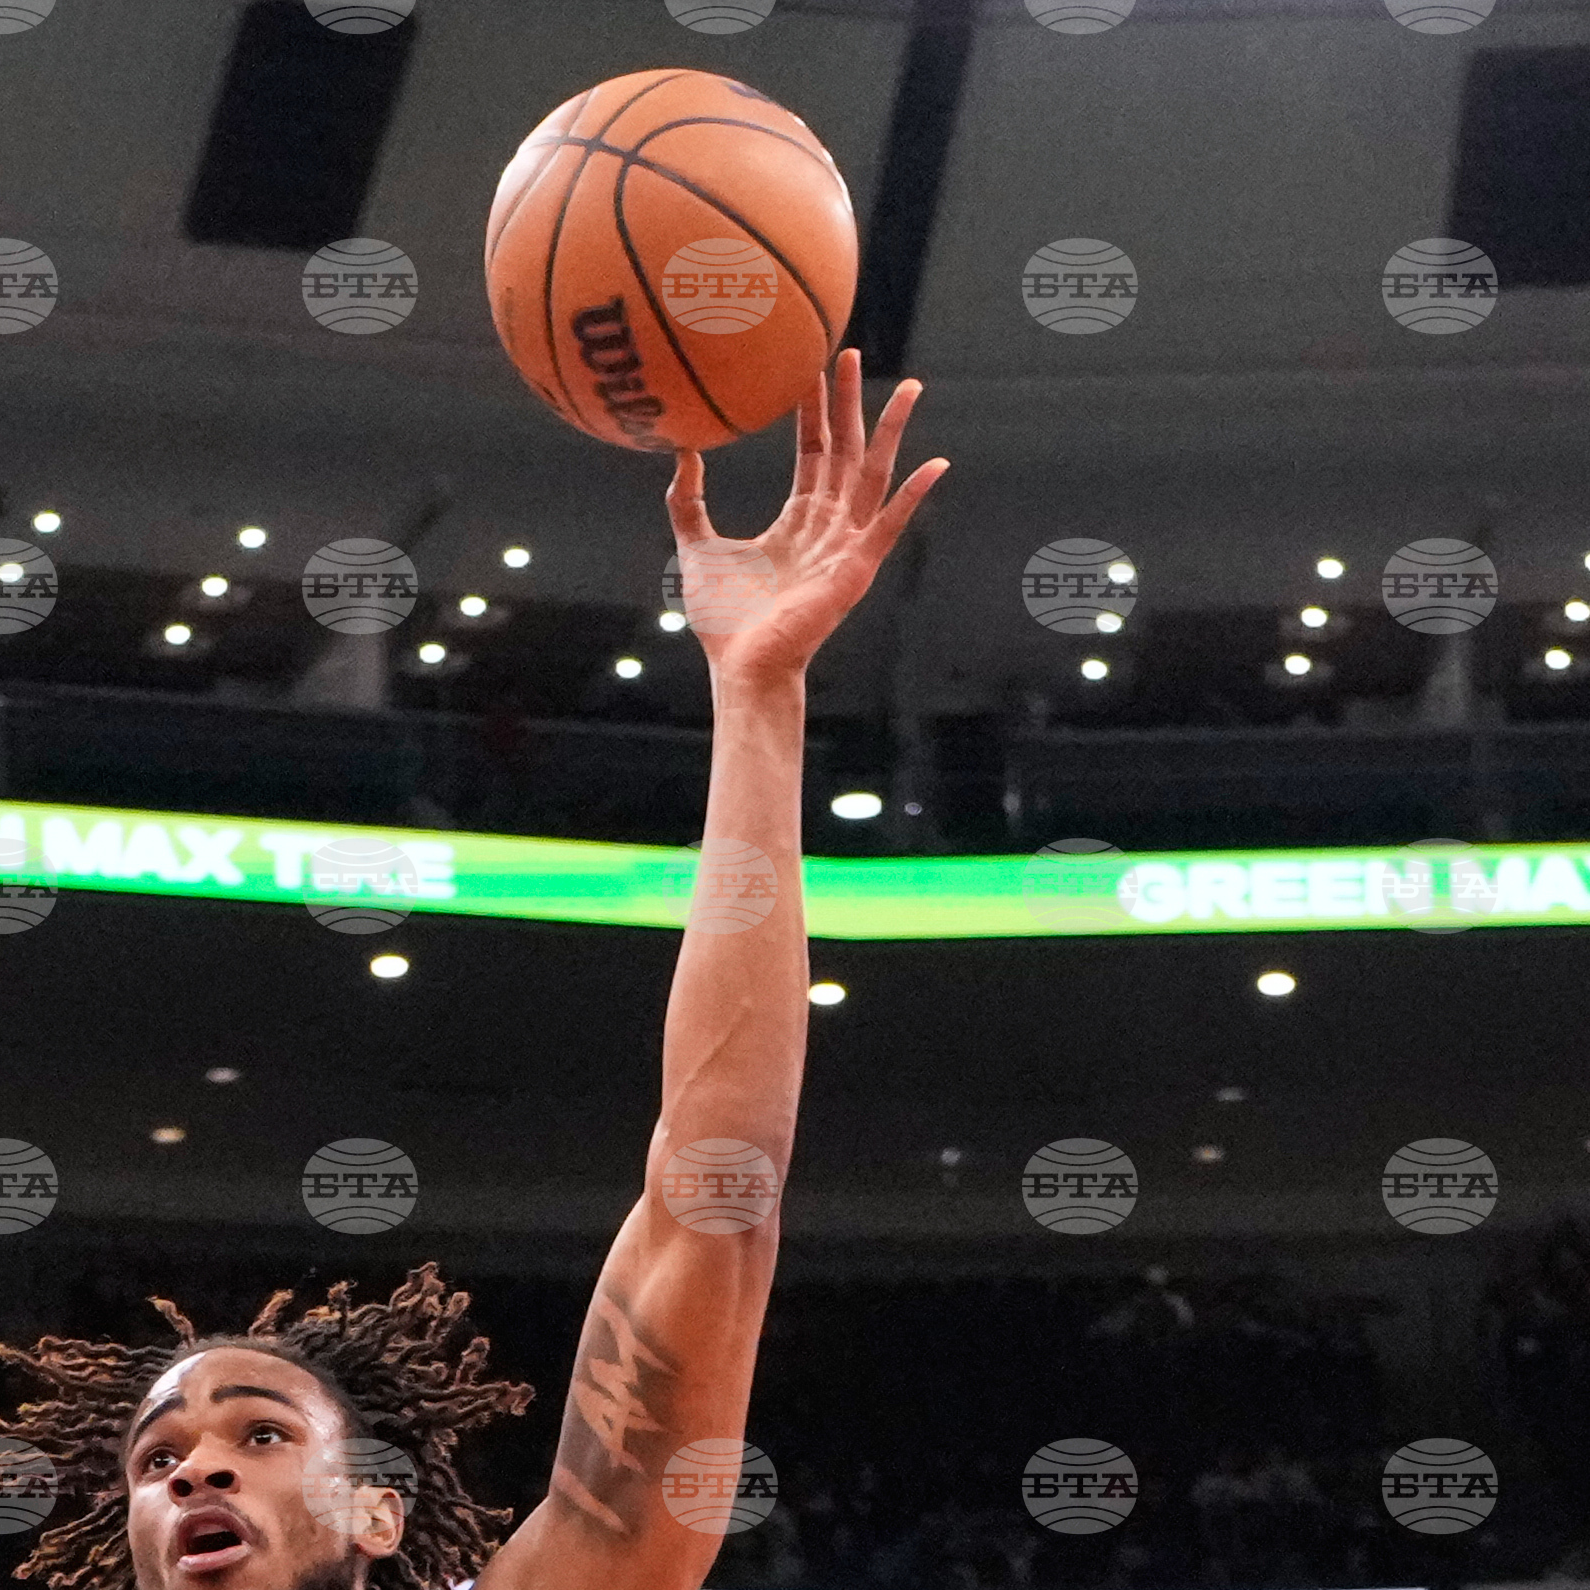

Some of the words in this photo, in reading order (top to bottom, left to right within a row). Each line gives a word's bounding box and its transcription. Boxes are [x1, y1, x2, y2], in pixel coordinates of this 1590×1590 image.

[42, 815, 244, 886] MAX
[259, 831, 456, 899] TIRE
[1118, 856, 1433, 922] GREEN
[1450, 854, 1590, 914] MA
